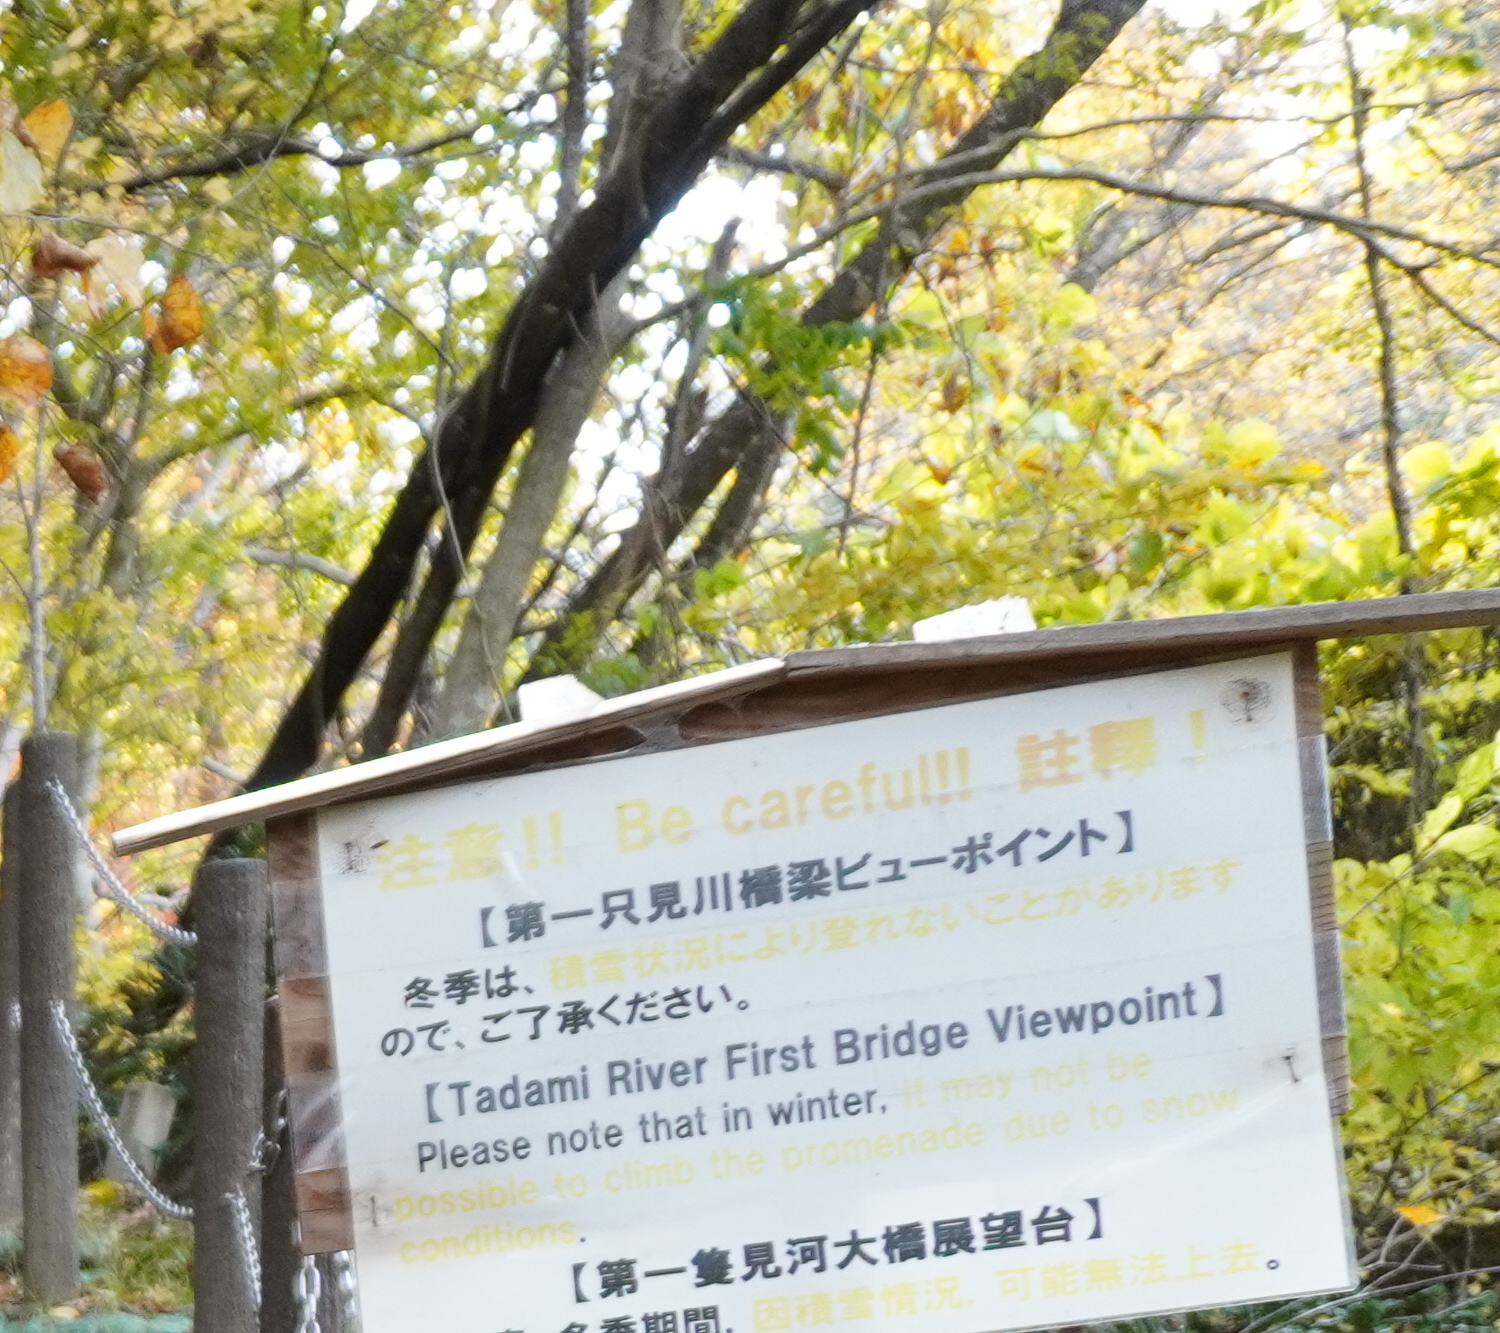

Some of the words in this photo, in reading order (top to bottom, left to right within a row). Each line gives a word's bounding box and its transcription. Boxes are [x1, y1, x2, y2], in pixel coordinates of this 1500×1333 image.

[616, 800, 691, 851] Be
[381, 985, 749, 1057] ので、ご了承ください。
[608, 1057, 707, 1096] River
[727, 1035, 815, 1081] First
[834, 1019, 968, 1066] Bridge
[418, 1136, 531, 1172] Please
[548, 1119, 623, 1156] note
[640, 1106, 707, 1144] that
[724, 1101, 752, 1133] in
[769, 1087, 887, 1126] winter,
[903, 1077, 929, 1108] it
[943, 1068, 1014, 1102] may
[1032, 1054, 1089, 1092] not
[1108, 1051, 1153, 1081] be
[394, 1176, 538, 1222] possible
[553, 1170, 587, 1200] to
[604, 1157, 695, 1194] climb
[711, 1144, 766, 1180] the
[783, 1118, 985, 1173] promenade
[1004, 1109, 1070, 1143] due
[1088, 1099, 1124, 1131] to
[1143, 1087, 1238, 1124] snow
[402, 1220, 586, 1263] conditions.
